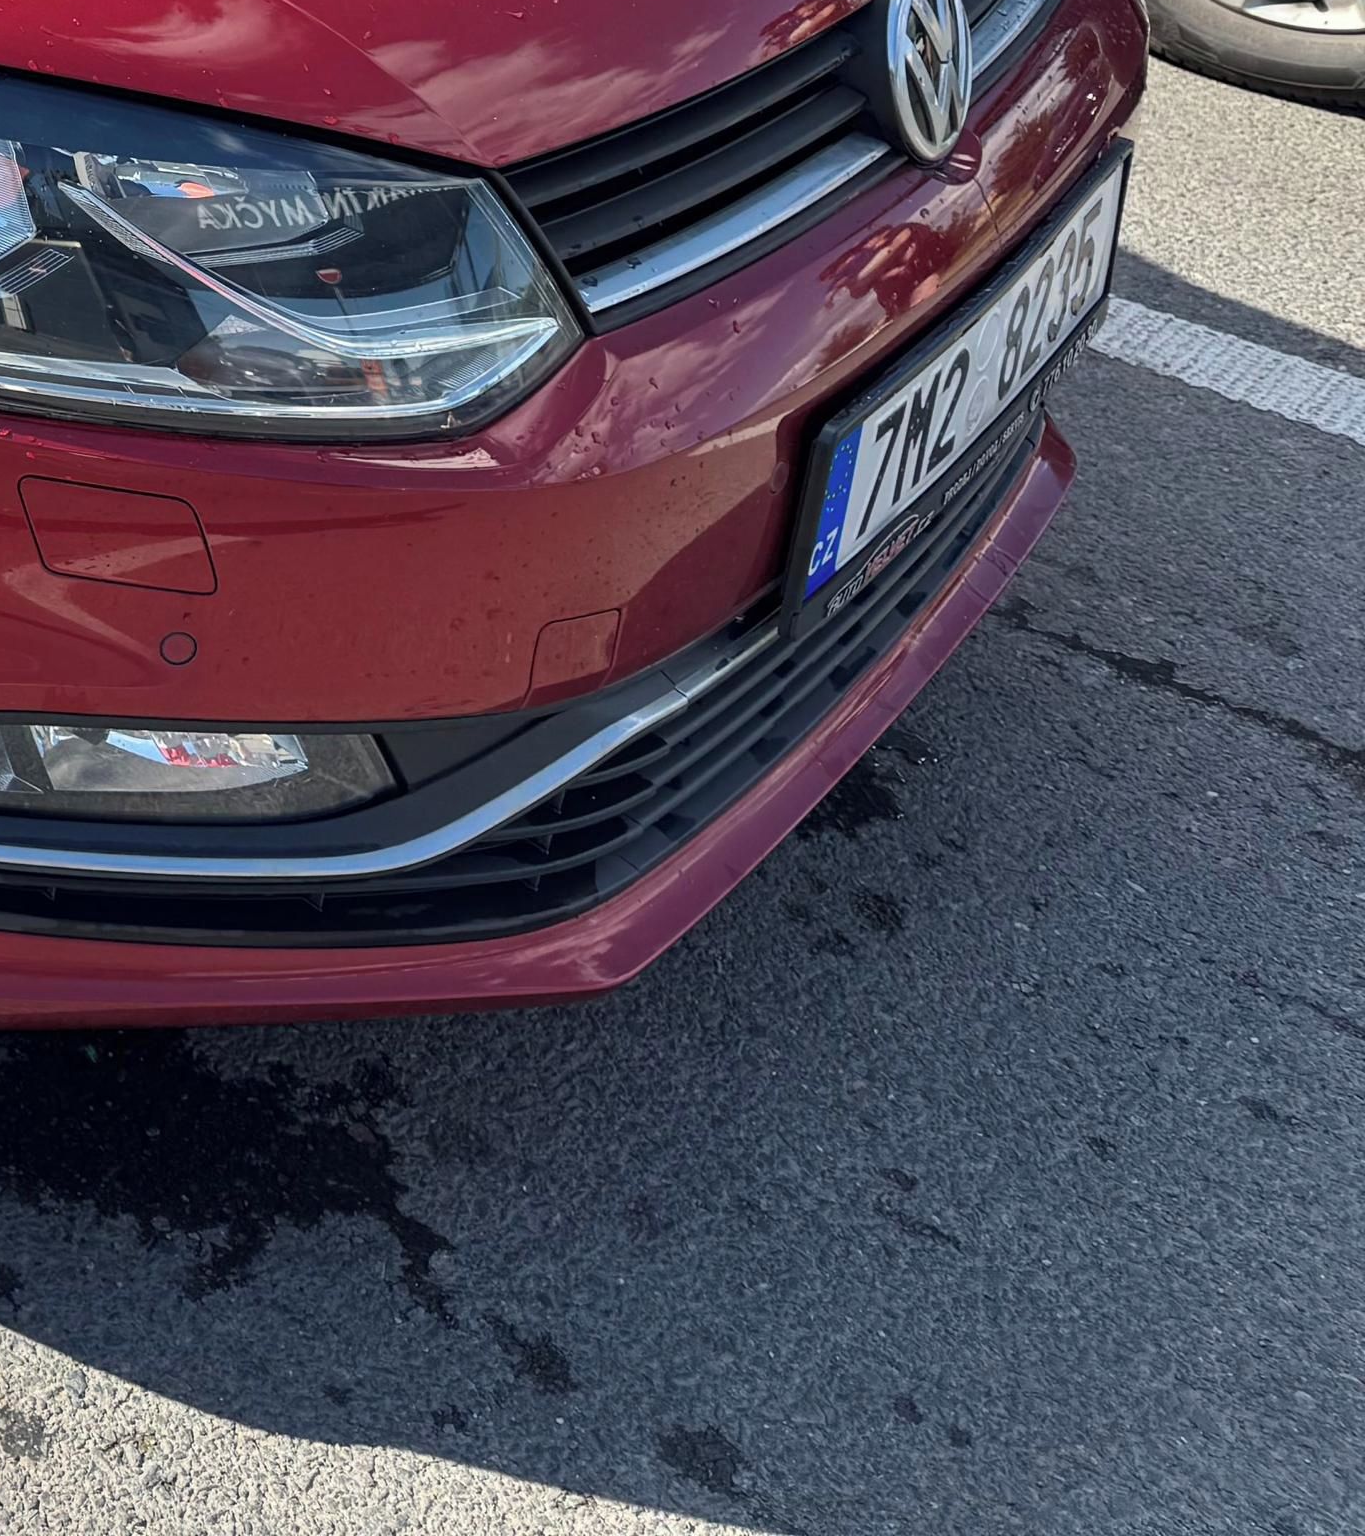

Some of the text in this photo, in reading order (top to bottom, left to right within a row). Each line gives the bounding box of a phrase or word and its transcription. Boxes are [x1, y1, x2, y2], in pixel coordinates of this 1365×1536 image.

[854, 197, 1104, 541] 7M2 8235
[807, 526, 839, 576] CZ
